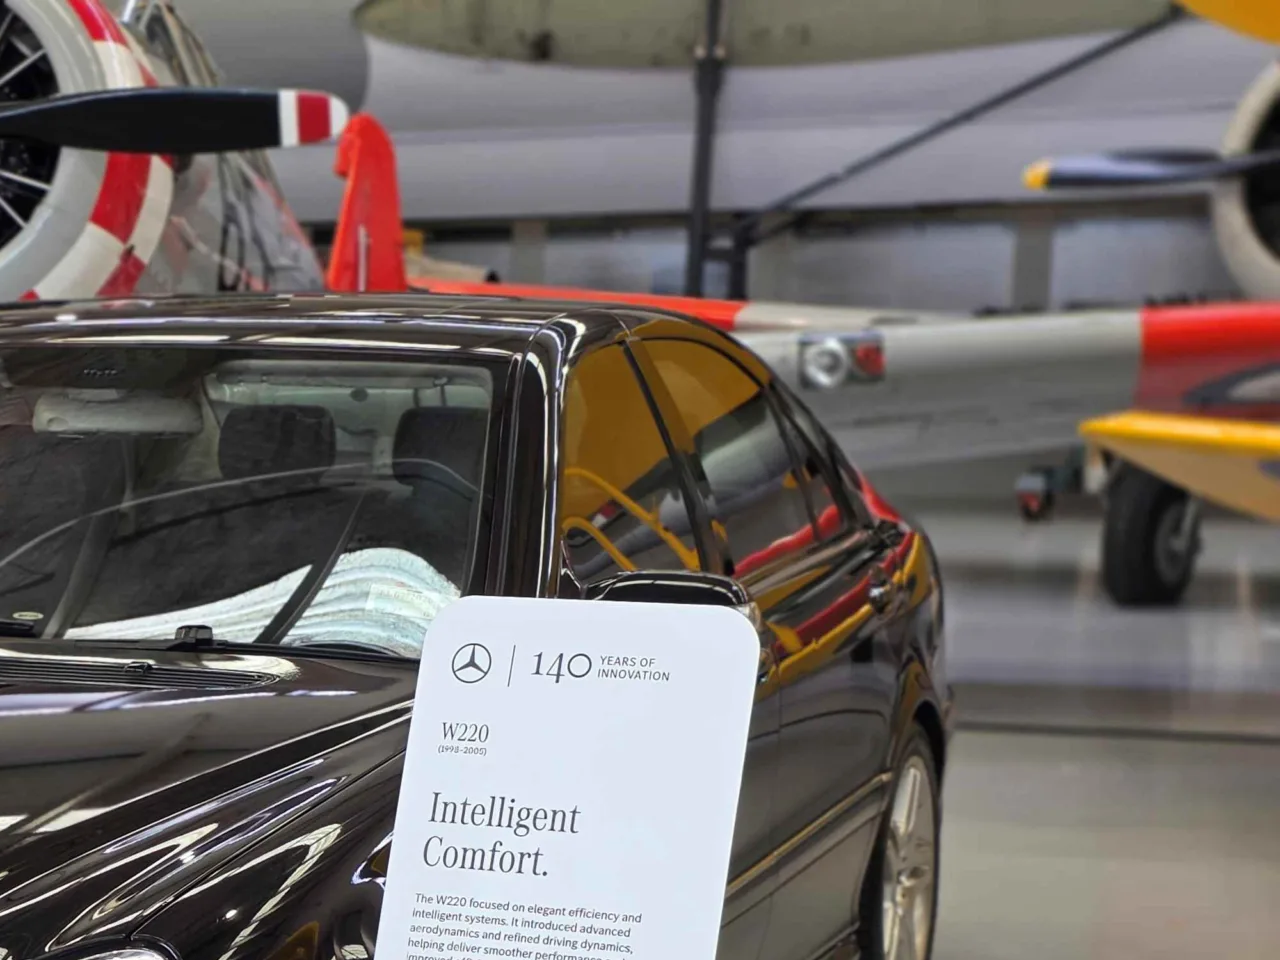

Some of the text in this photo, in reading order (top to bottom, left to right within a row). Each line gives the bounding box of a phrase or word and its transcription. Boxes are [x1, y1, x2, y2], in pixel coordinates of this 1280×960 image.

[531, 651, 592, 684] 140
[597, 668, 670, 682] INNOVATION
[600, 655, 656, 668] YEARS OF
[442, 722, 490, 743] W220
[428, 791, 582, 837] Intelligent
[423, 835, 548, 877] Comfort.
[412, 908, 631, 938] intelligent systems. It introduced advanced
[416, 893, 642, 923] The W220 focused on elegant efficiency and
[407, 937, 445, 952] helping
[446, 941, 482, 954] deliver
[483, 946, 533, 959] smoother
[409, 924, 634, 955] aerodynamics and refined driving dynamics,
